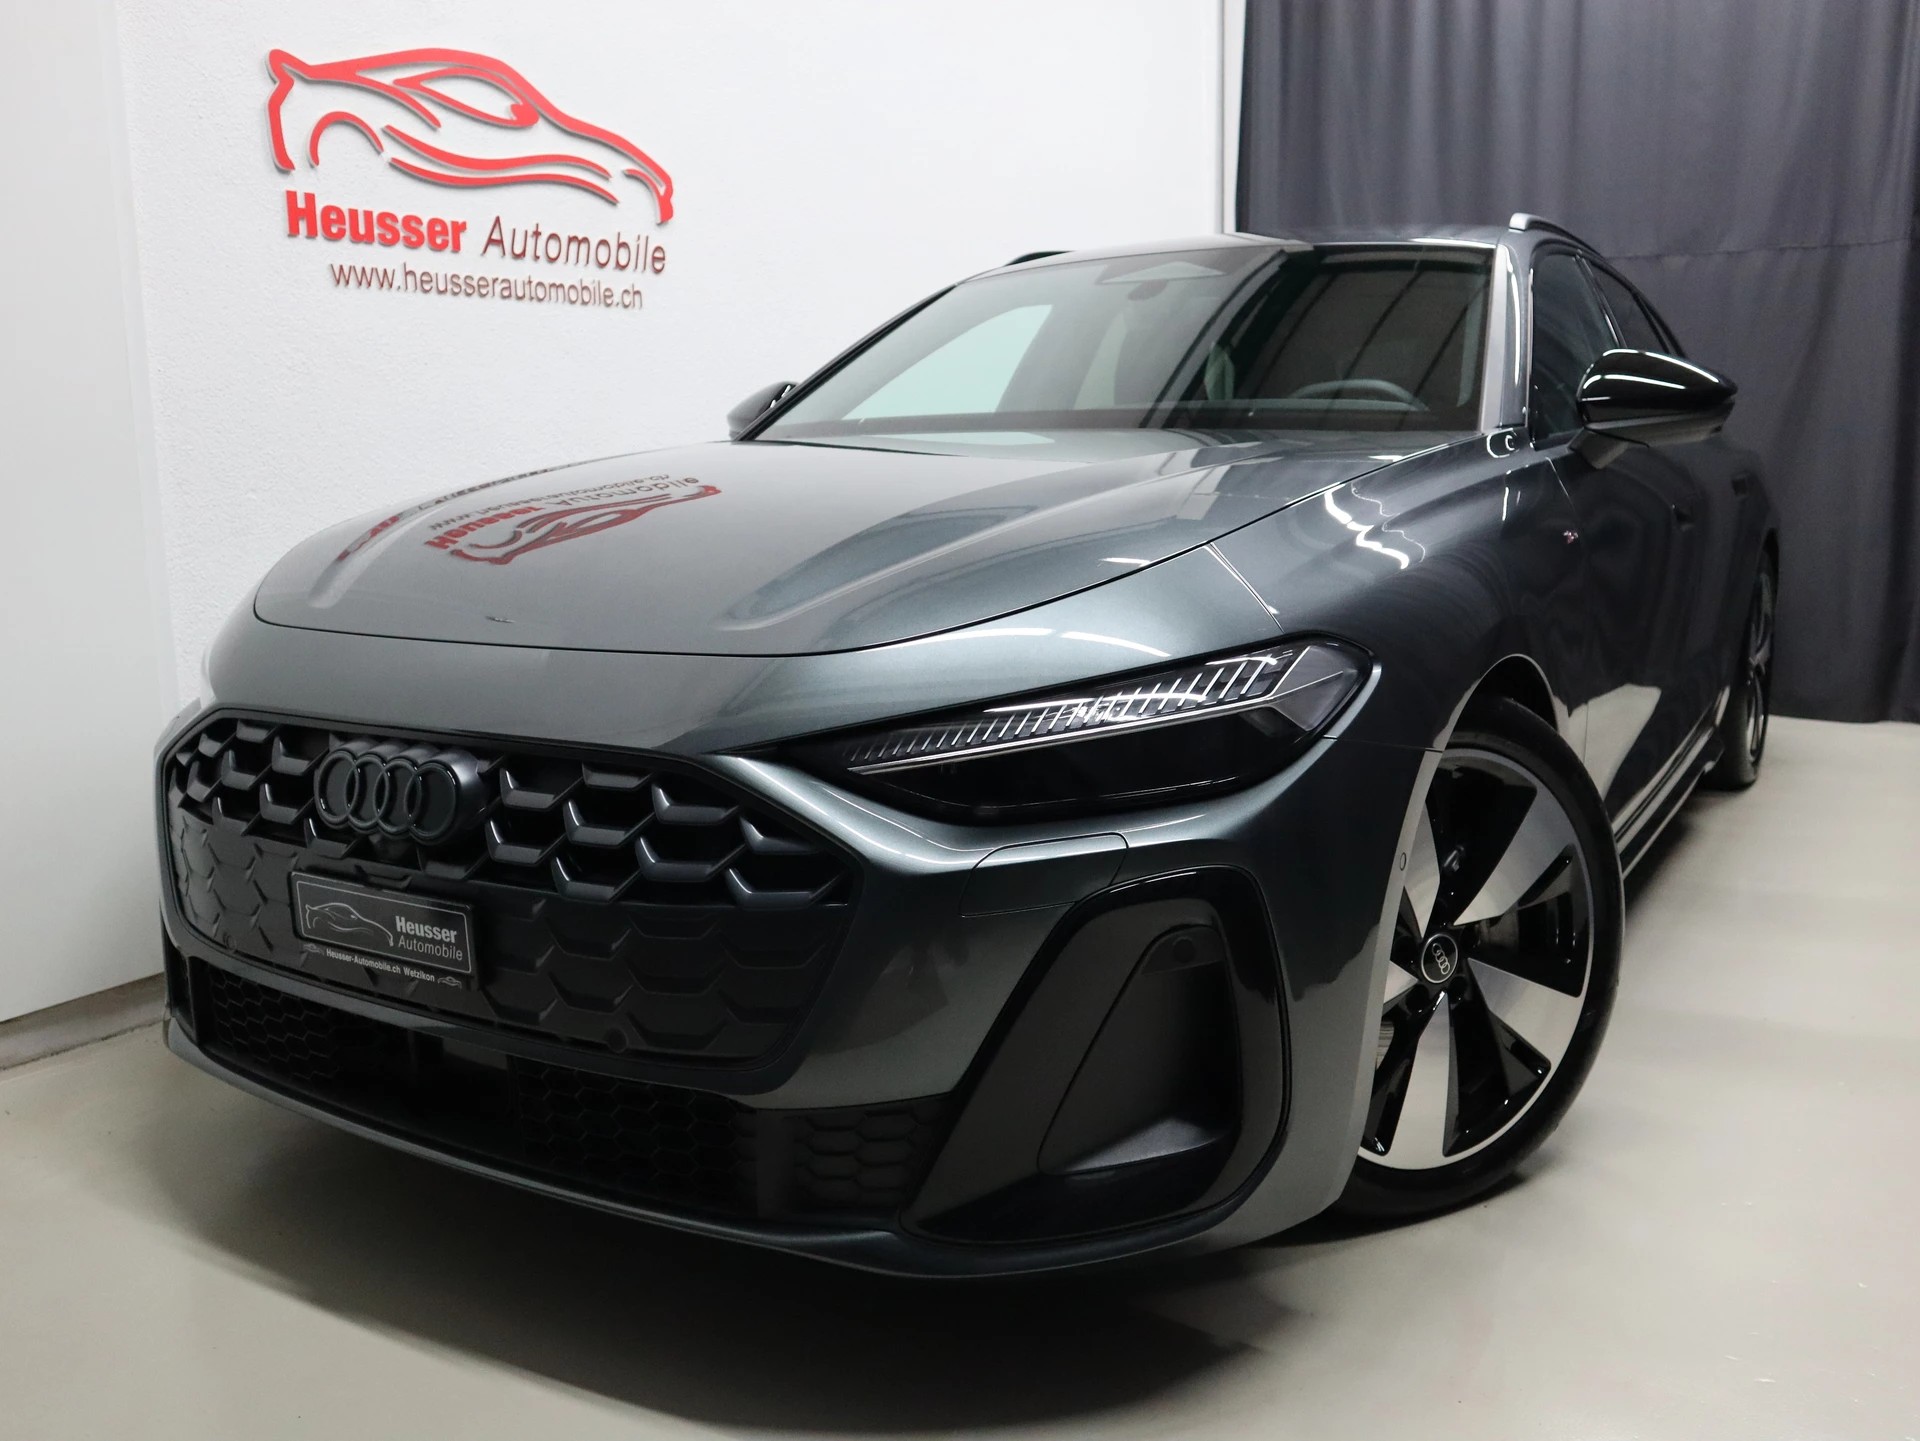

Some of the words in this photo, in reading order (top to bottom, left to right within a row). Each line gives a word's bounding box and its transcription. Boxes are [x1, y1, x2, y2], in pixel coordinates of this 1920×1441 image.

[285, 190, 468, 254] Heusser
[481, 215, 668, 275] Automobile
[330, 262, 644, 310] www.heusserautomobile.ch
[395, 915, 458, 944] Heusser
[326, 948, 401, 974] Heusser-Automobile.ch
[403, 967, 435, 982] Wetzikon
[398, 935, 463, 961] Automobile
